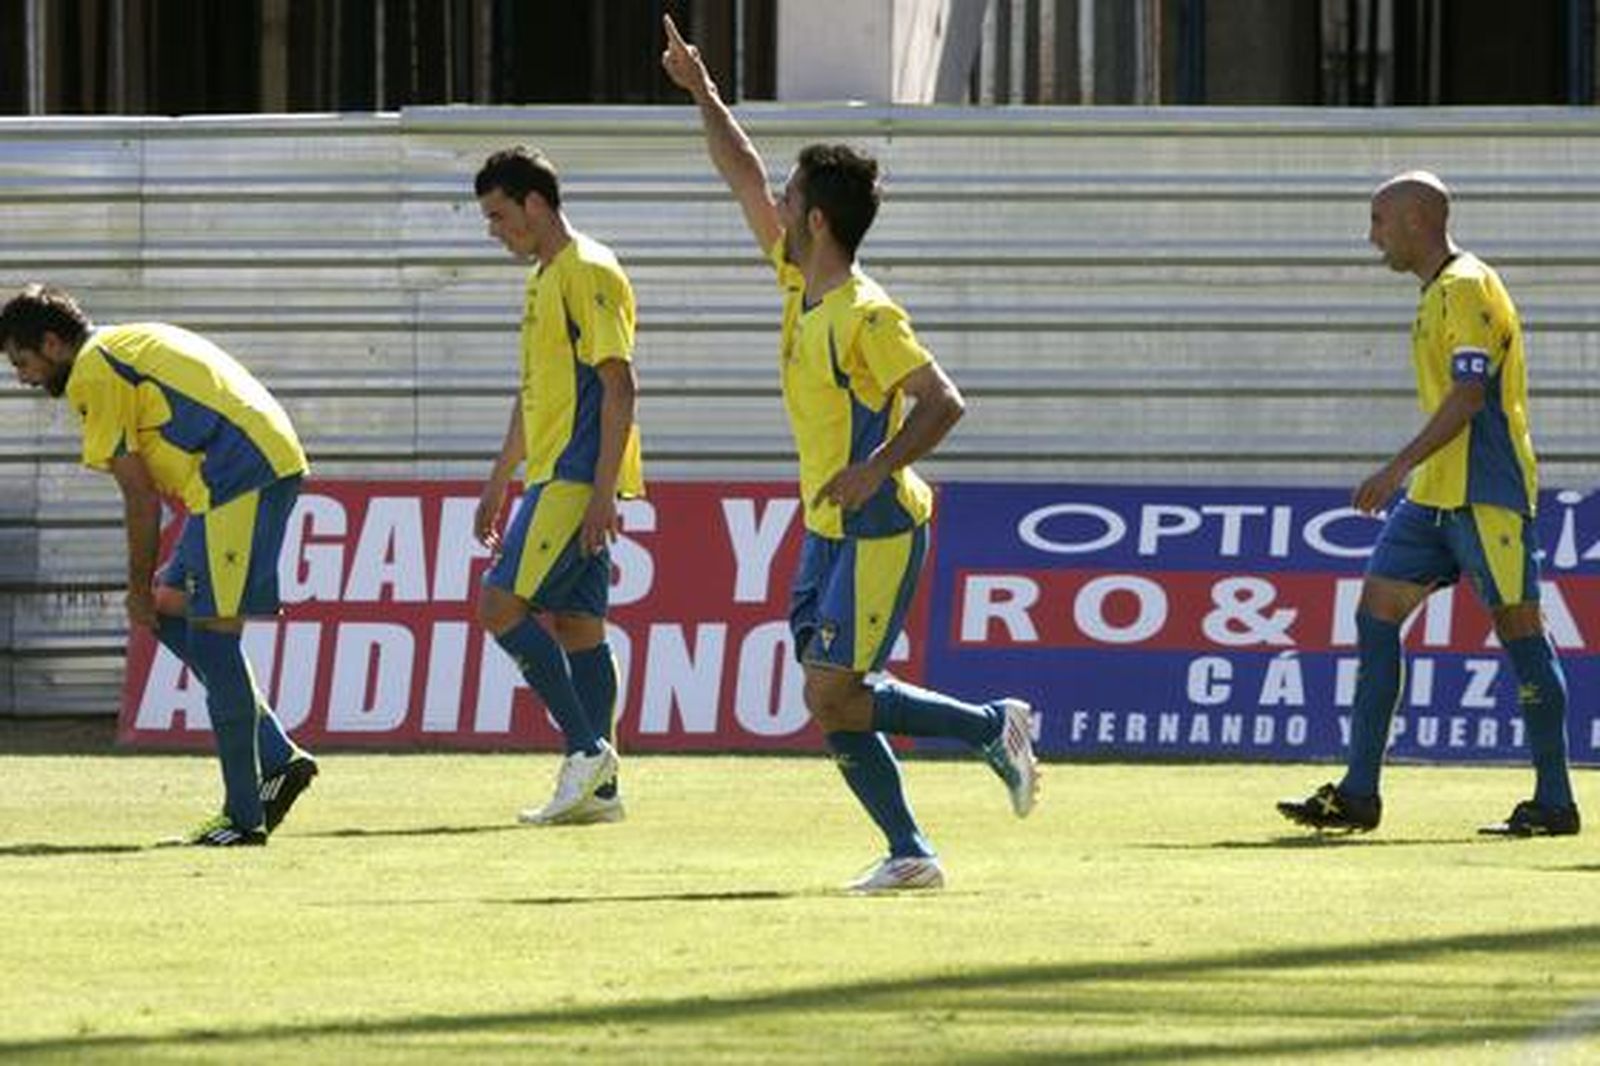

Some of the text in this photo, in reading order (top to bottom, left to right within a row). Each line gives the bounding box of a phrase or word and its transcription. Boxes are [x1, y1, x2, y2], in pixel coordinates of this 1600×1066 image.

[278, 494, 800, 606] GAFS Y
[134, 617, 910, 736] AUDIFNO
[1070, 711, 1308, 746] FERNANDO
[1389, 715, 1525, 749] PUERT
